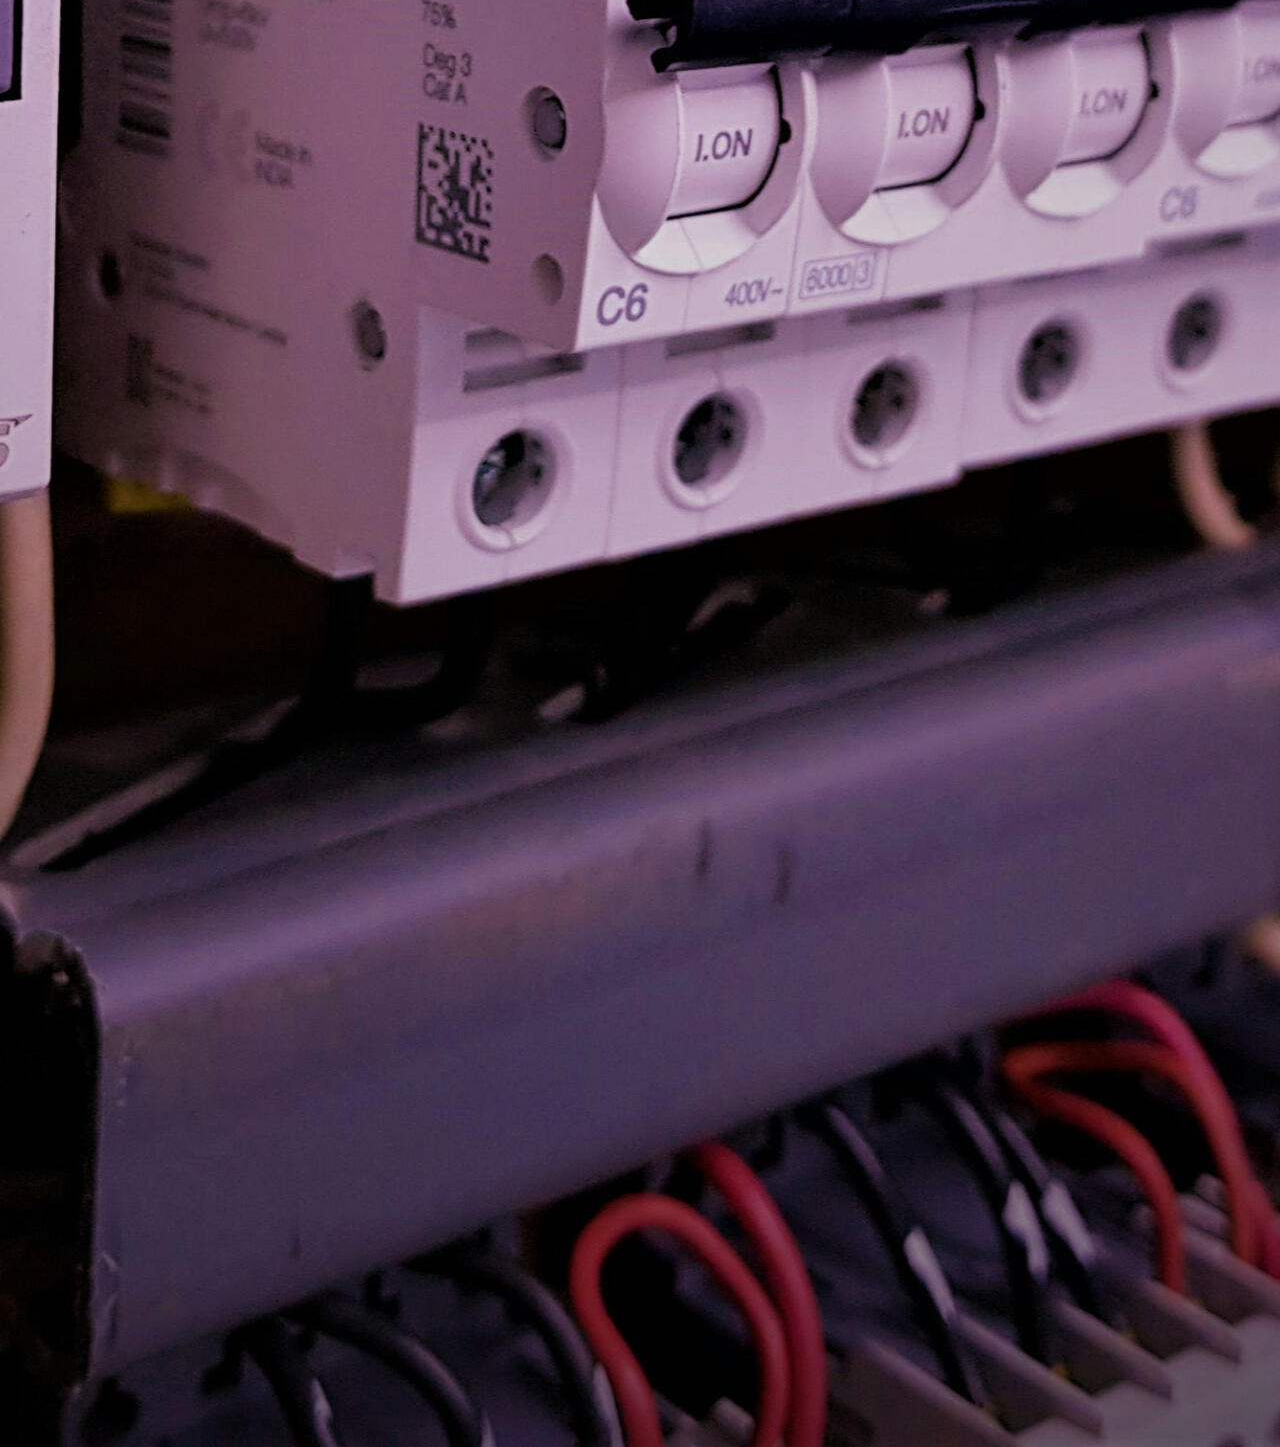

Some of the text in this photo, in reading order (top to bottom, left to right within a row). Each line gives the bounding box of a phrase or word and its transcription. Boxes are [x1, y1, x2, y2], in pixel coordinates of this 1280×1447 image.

[896, 107, 950, 139] I.ON
[694, 128, 754, 163] I.ON
[596, 283, 649, 326] C6
